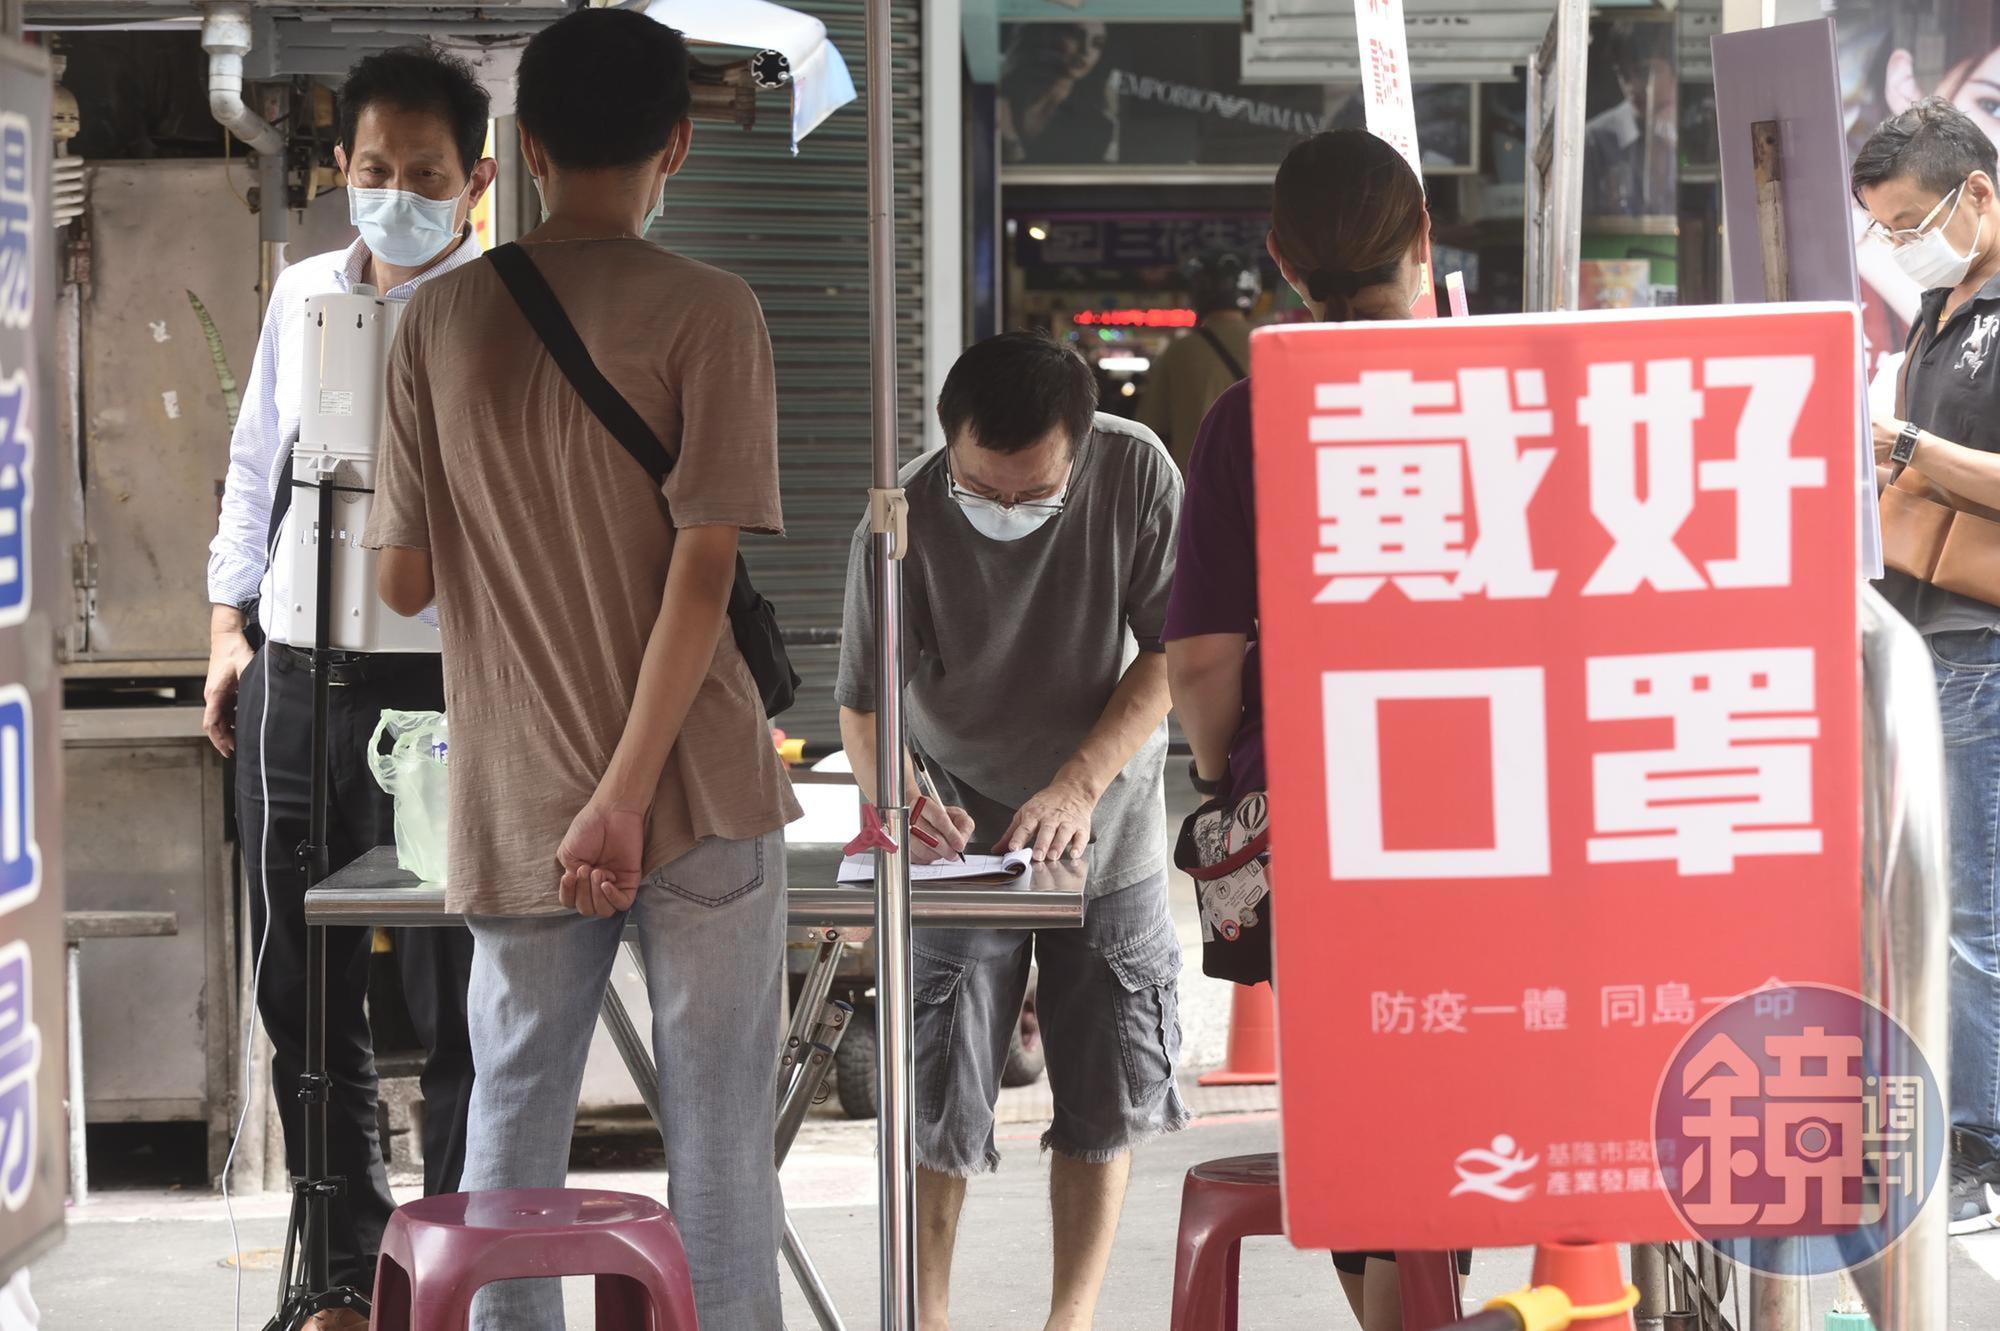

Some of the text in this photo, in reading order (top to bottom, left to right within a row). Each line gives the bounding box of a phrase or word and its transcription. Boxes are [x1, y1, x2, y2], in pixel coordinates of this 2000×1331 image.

[1308, 355, 1828, 603] 戴好
[1321, 647, 1824, 881] 口罩
[1371, 976, 1798, 1034] 防疫一體 同島一命
